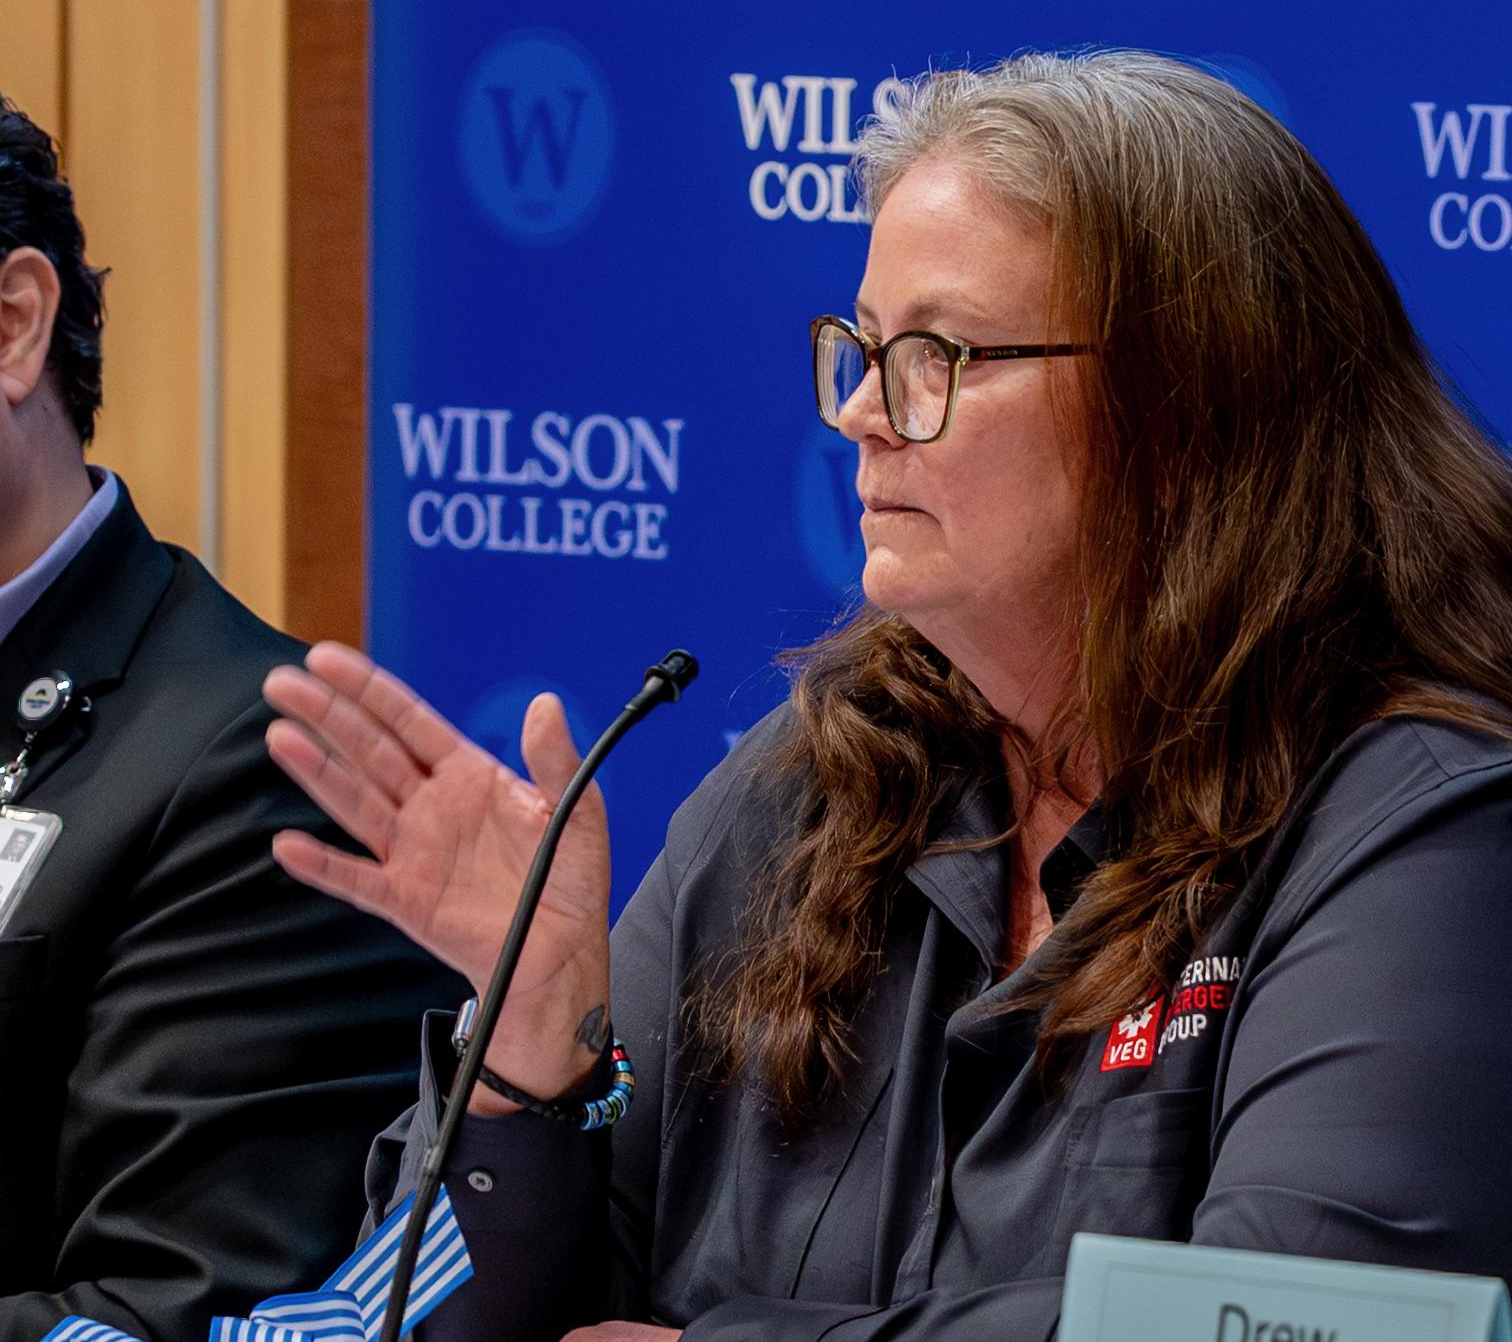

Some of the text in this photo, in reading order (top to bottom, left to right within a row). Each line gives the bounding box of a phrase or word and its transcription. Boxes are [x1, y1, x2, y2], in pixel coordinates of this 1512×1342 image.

[487, 87, 586, 188] W
[394, 404, 682, 491] WILSON
[409, 492, 666, 559] COLLEGE
[1110, 1038, 1147, 1064] VEG
